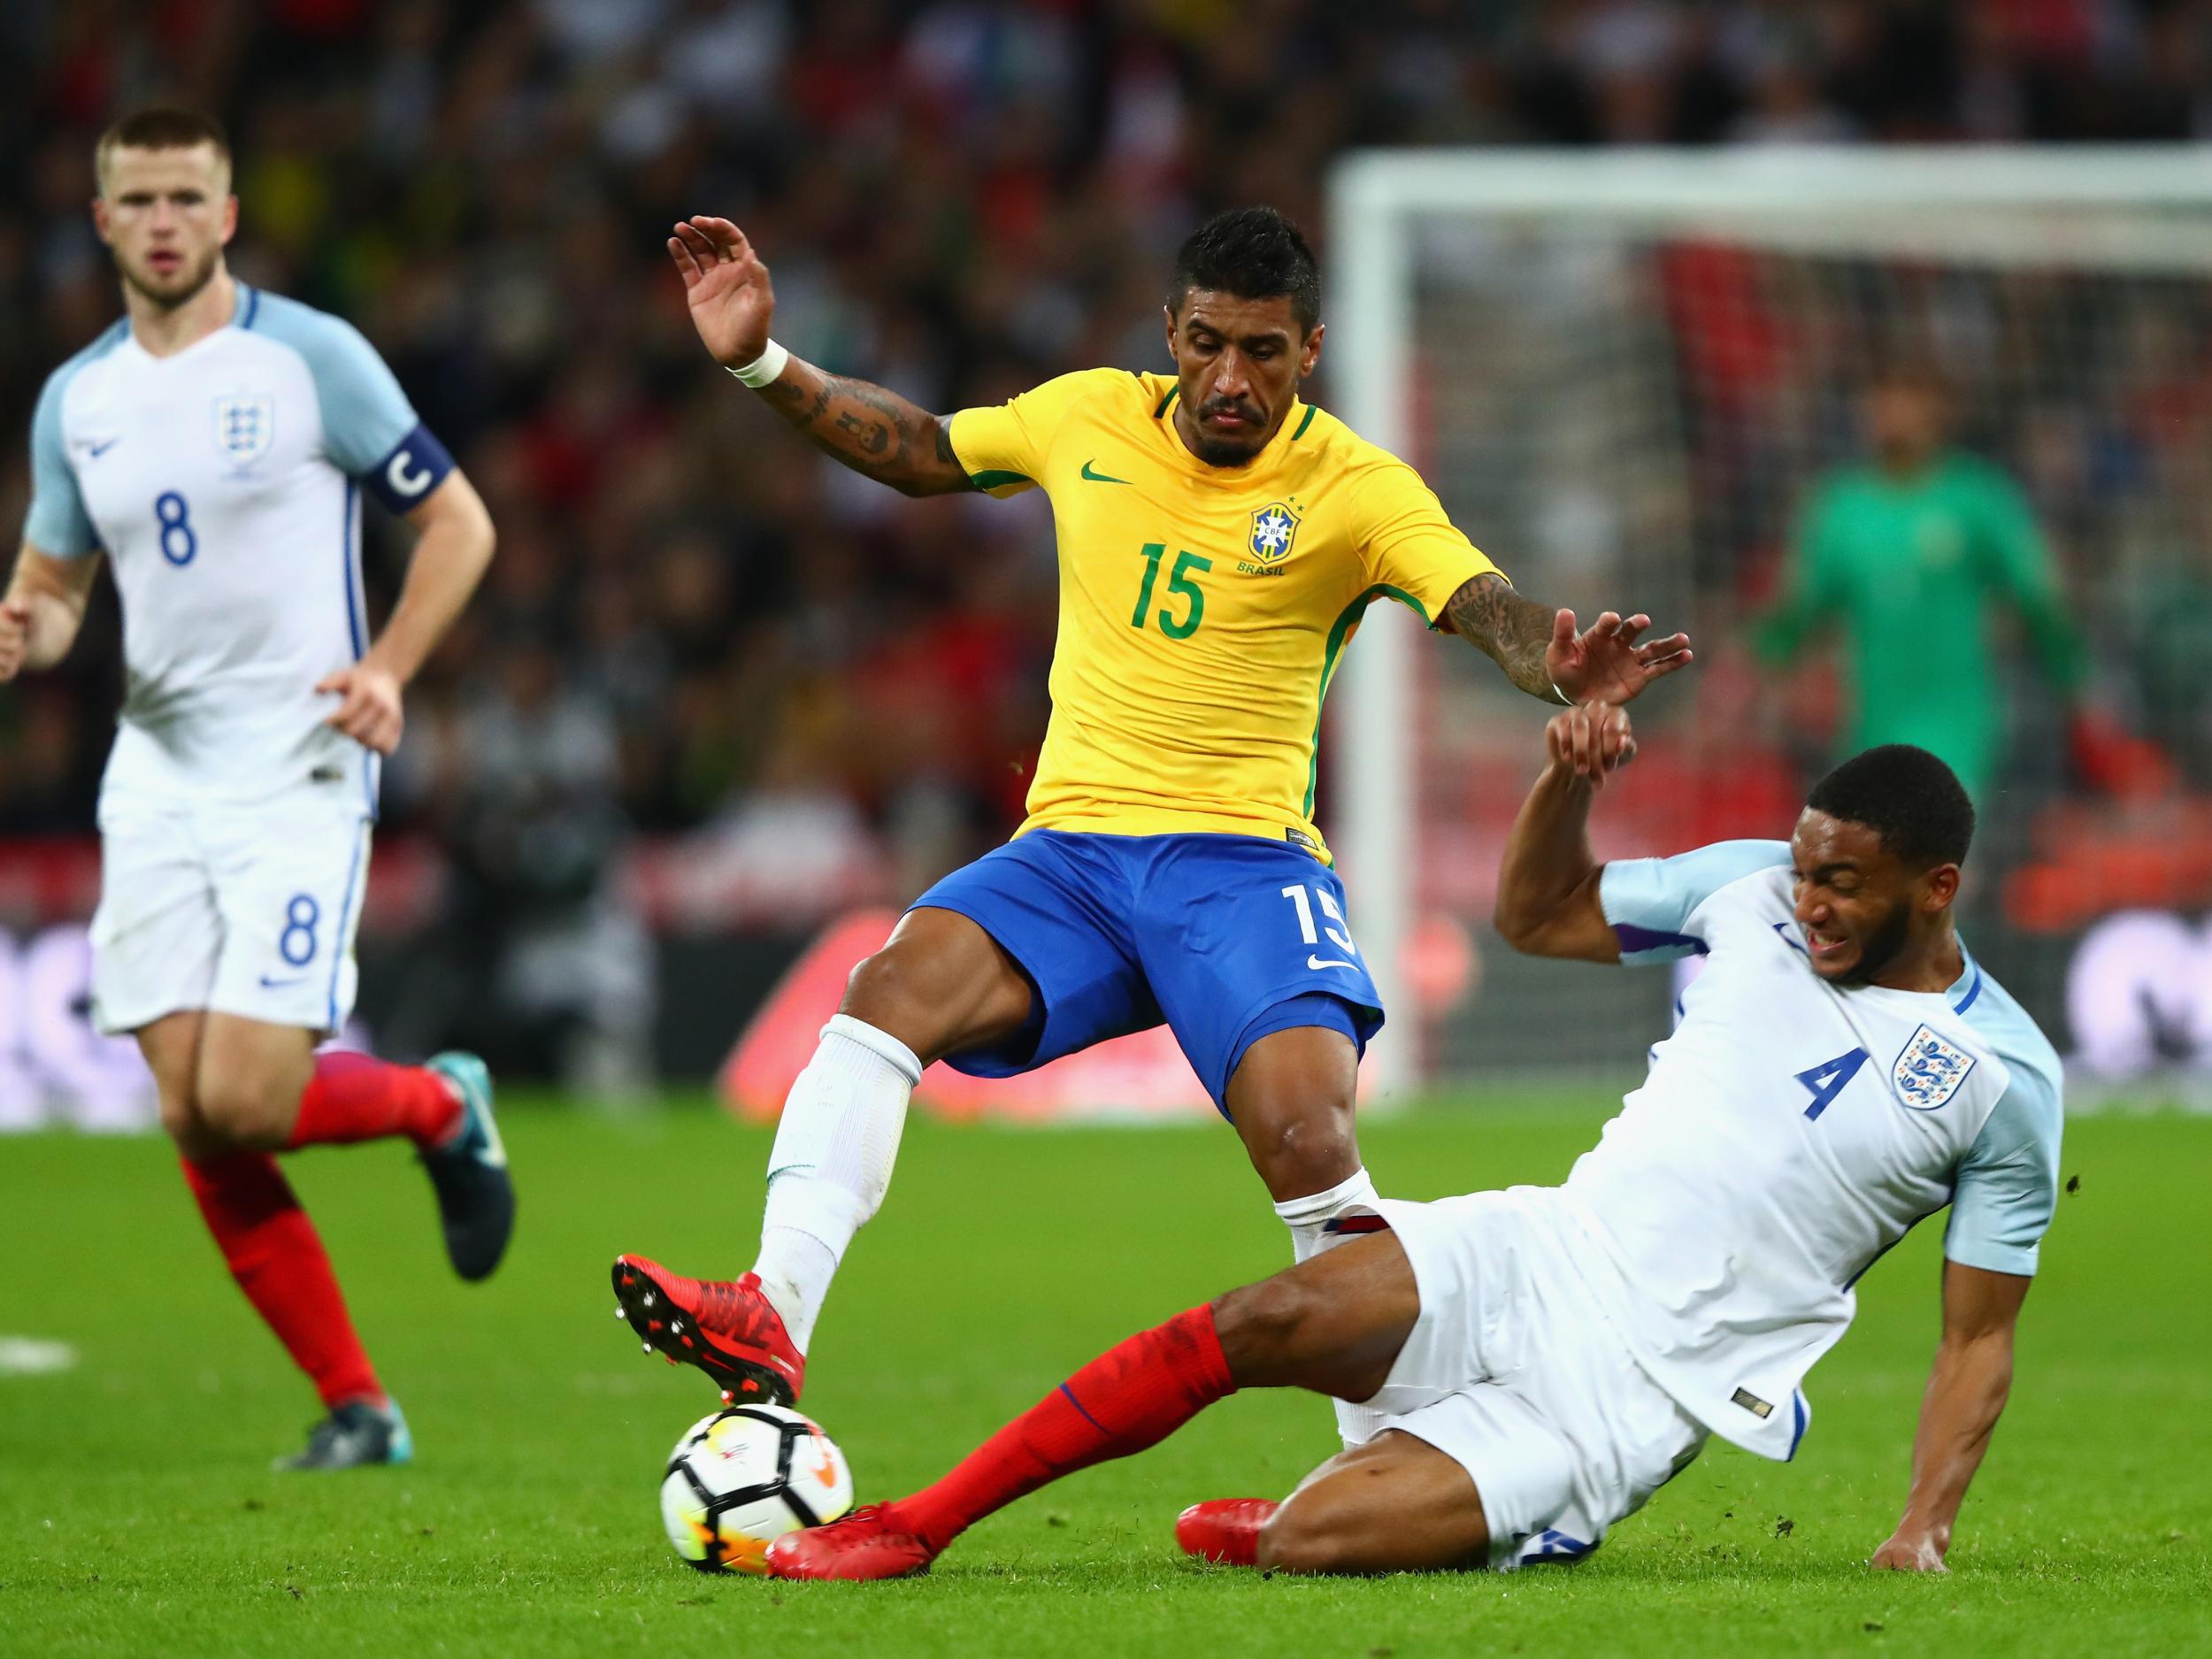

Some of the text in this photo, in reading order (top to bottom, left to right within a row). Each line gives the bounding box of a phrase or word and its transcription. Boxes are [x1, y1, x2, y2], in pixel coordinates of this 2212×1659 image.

[388, 450, 433, 496] C
[155, 489, 196, 567] 8
[1264, 526, 1281, 535] CBF
[1131, 542, 1213, 640] 15
[1236, 561, 1286, 577] BRASIL
[280, 893, 319, 967] 8
[1281, 884, 1356, 956] 15
[1793, 1047, 1870, 1122] 4
